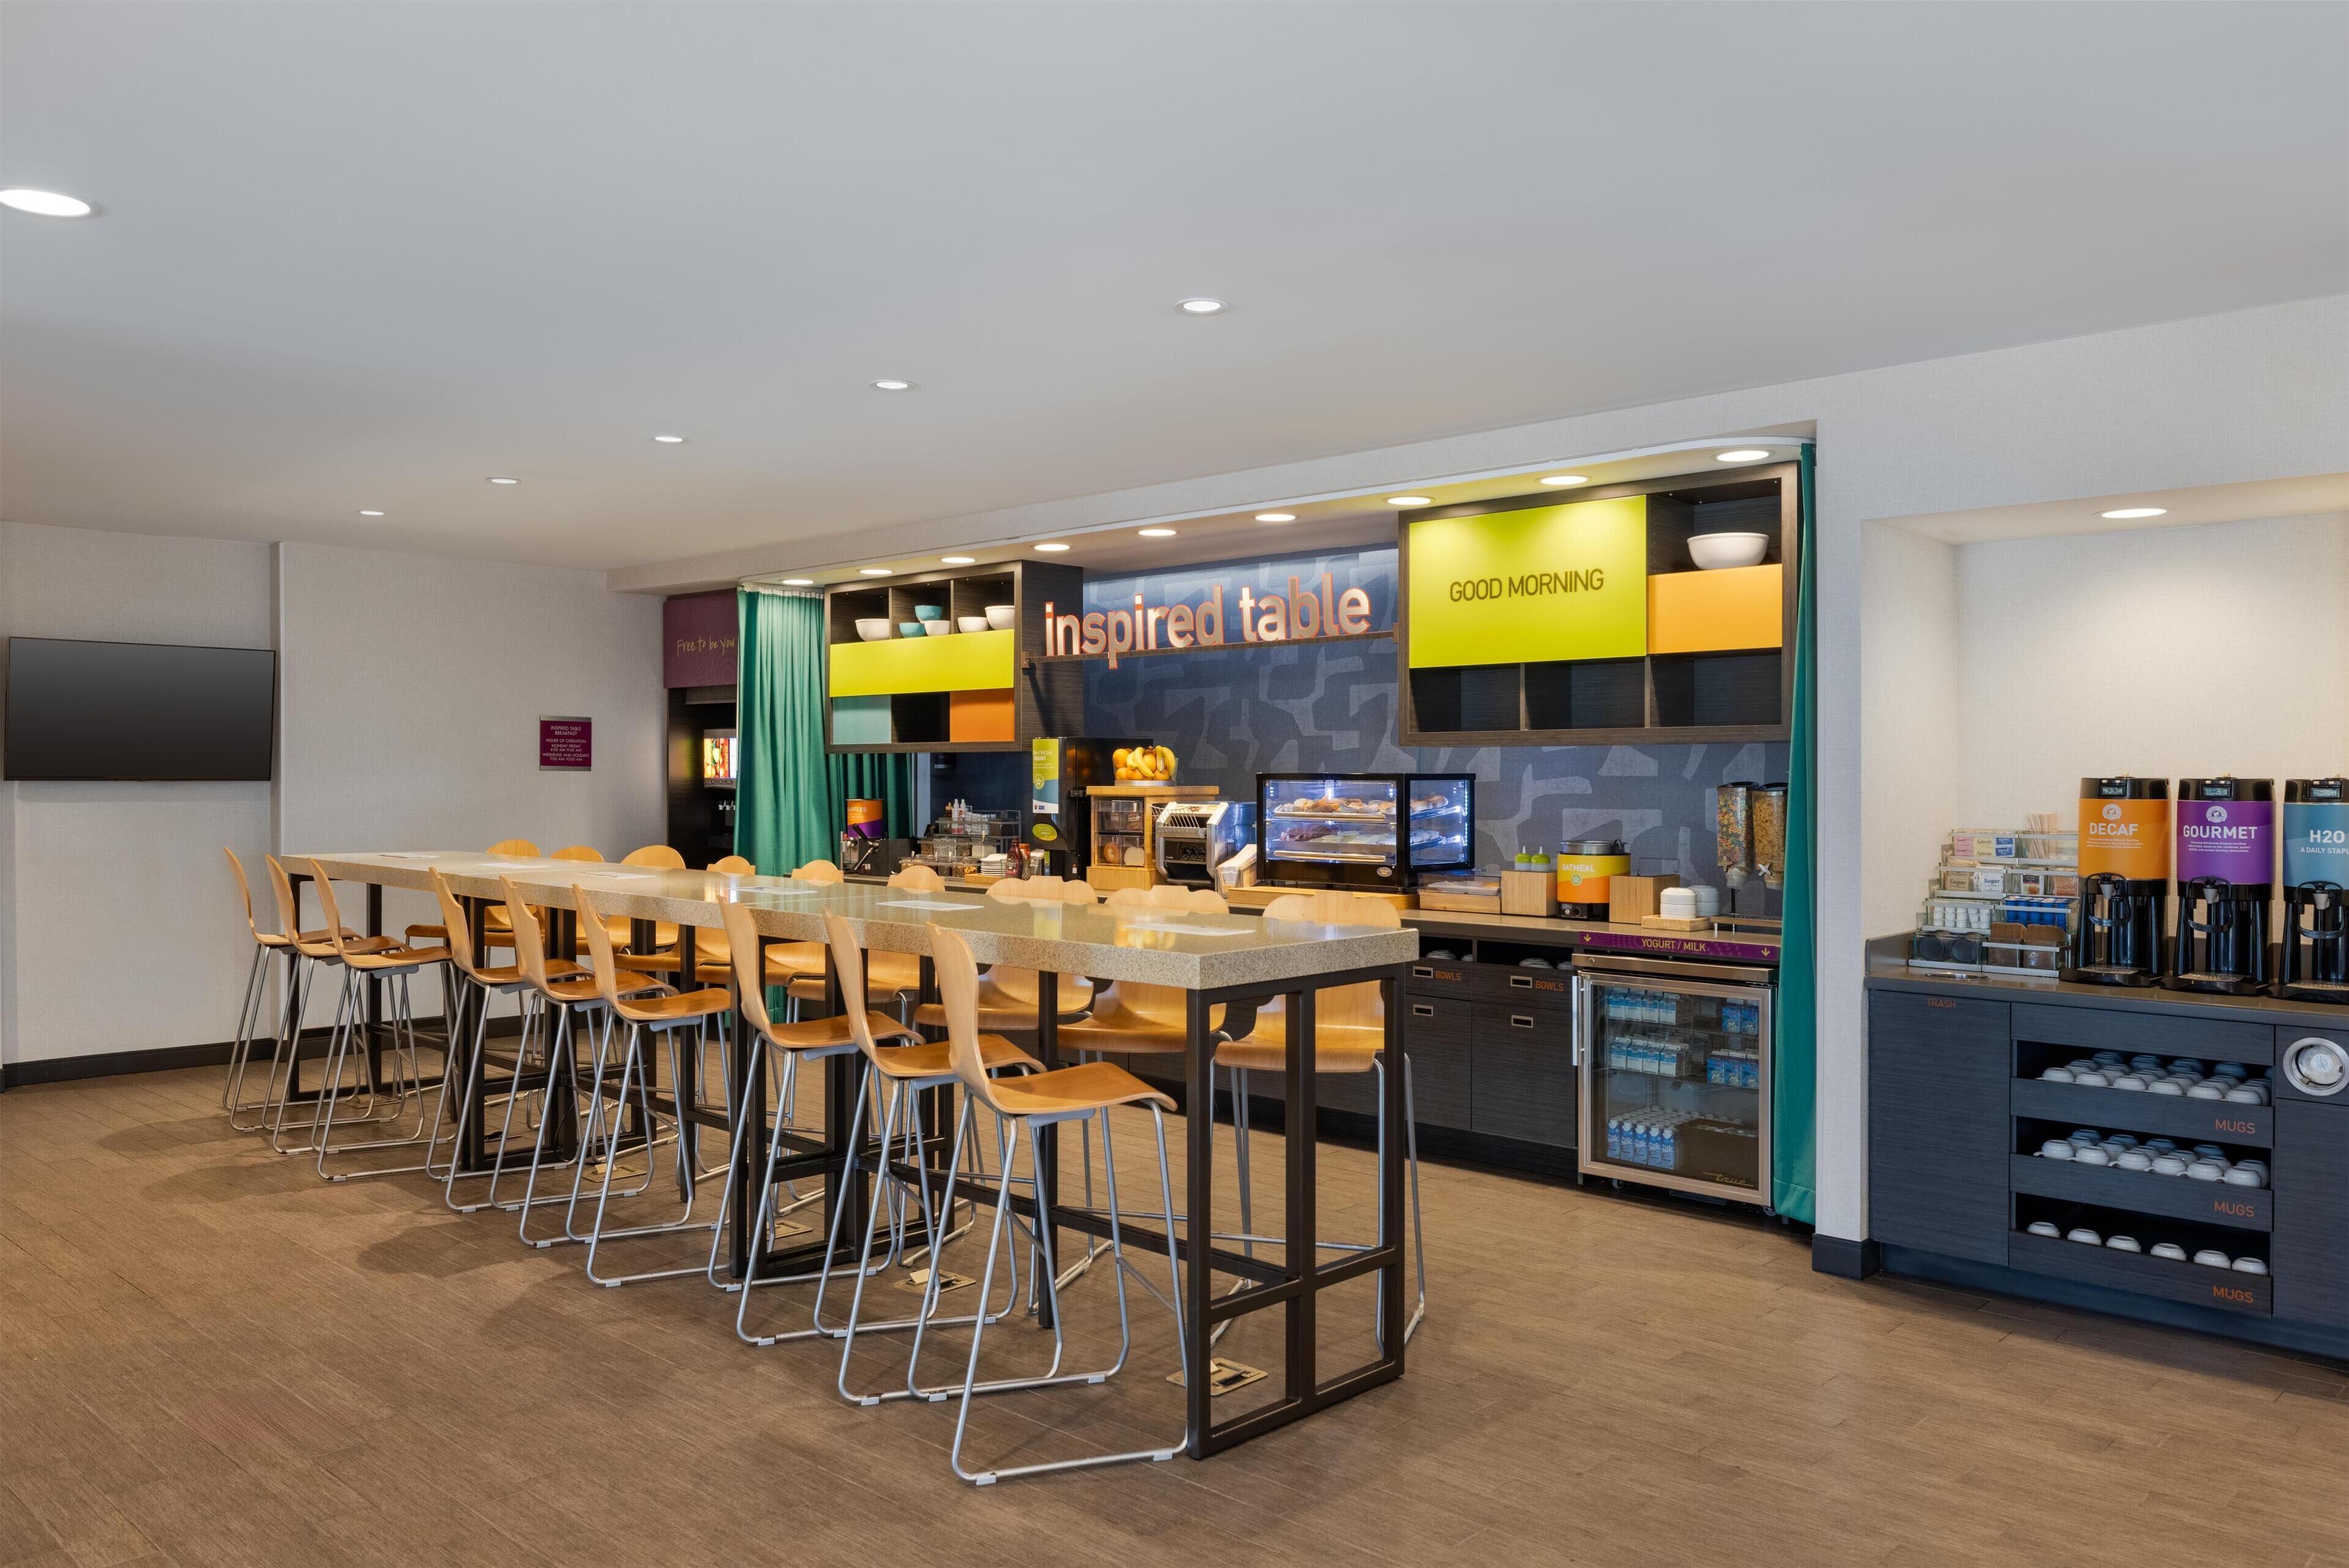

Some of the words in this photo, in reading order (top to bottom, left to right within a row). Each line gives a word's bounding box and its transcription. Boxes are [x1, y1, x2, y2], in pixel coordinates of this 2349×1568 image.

[1450, 578, 1502, 603] GOOD
[1508, 568, 1605, 598] MORNING
[1045, 585, 1224, 669] inspired
[1239, 573, 1371, 642] table
[677, 639, 696, 656] Free
[697, 636, 707, 652] to
[709, 636, 718, 651] be
[2089, 822, 2139, 836] DECAF
[2183, 825, 2257, 839] GOURMET
[2310, 830, 2345, 843] H2O
[1641, 938, 1675, 949] YOGURT
[1677, 941, 1682, 950] /
[1683, 942, 1706, 951] MILK
[1435, 970, 1461, 981] BOWLS
[1535, 980, 1564, 992] BOWLS
[1928, 998, 1956, 1009] TRASH
[2214, 1118, 2255, 1134] MUGS
[1608, 1134, 1619, 1142] Silk
[1621, 1136, 1633, 1145] Silk
[1634, 1139, 1647, 1148] Silk
[1648, 1142, 1661, 1151] Silk
[1662, 1144, 1674, 1153] Silk
[2214, 1200, 2255, 1217] MUGS
[2213, 1285, 2254, 1303] MUGS
